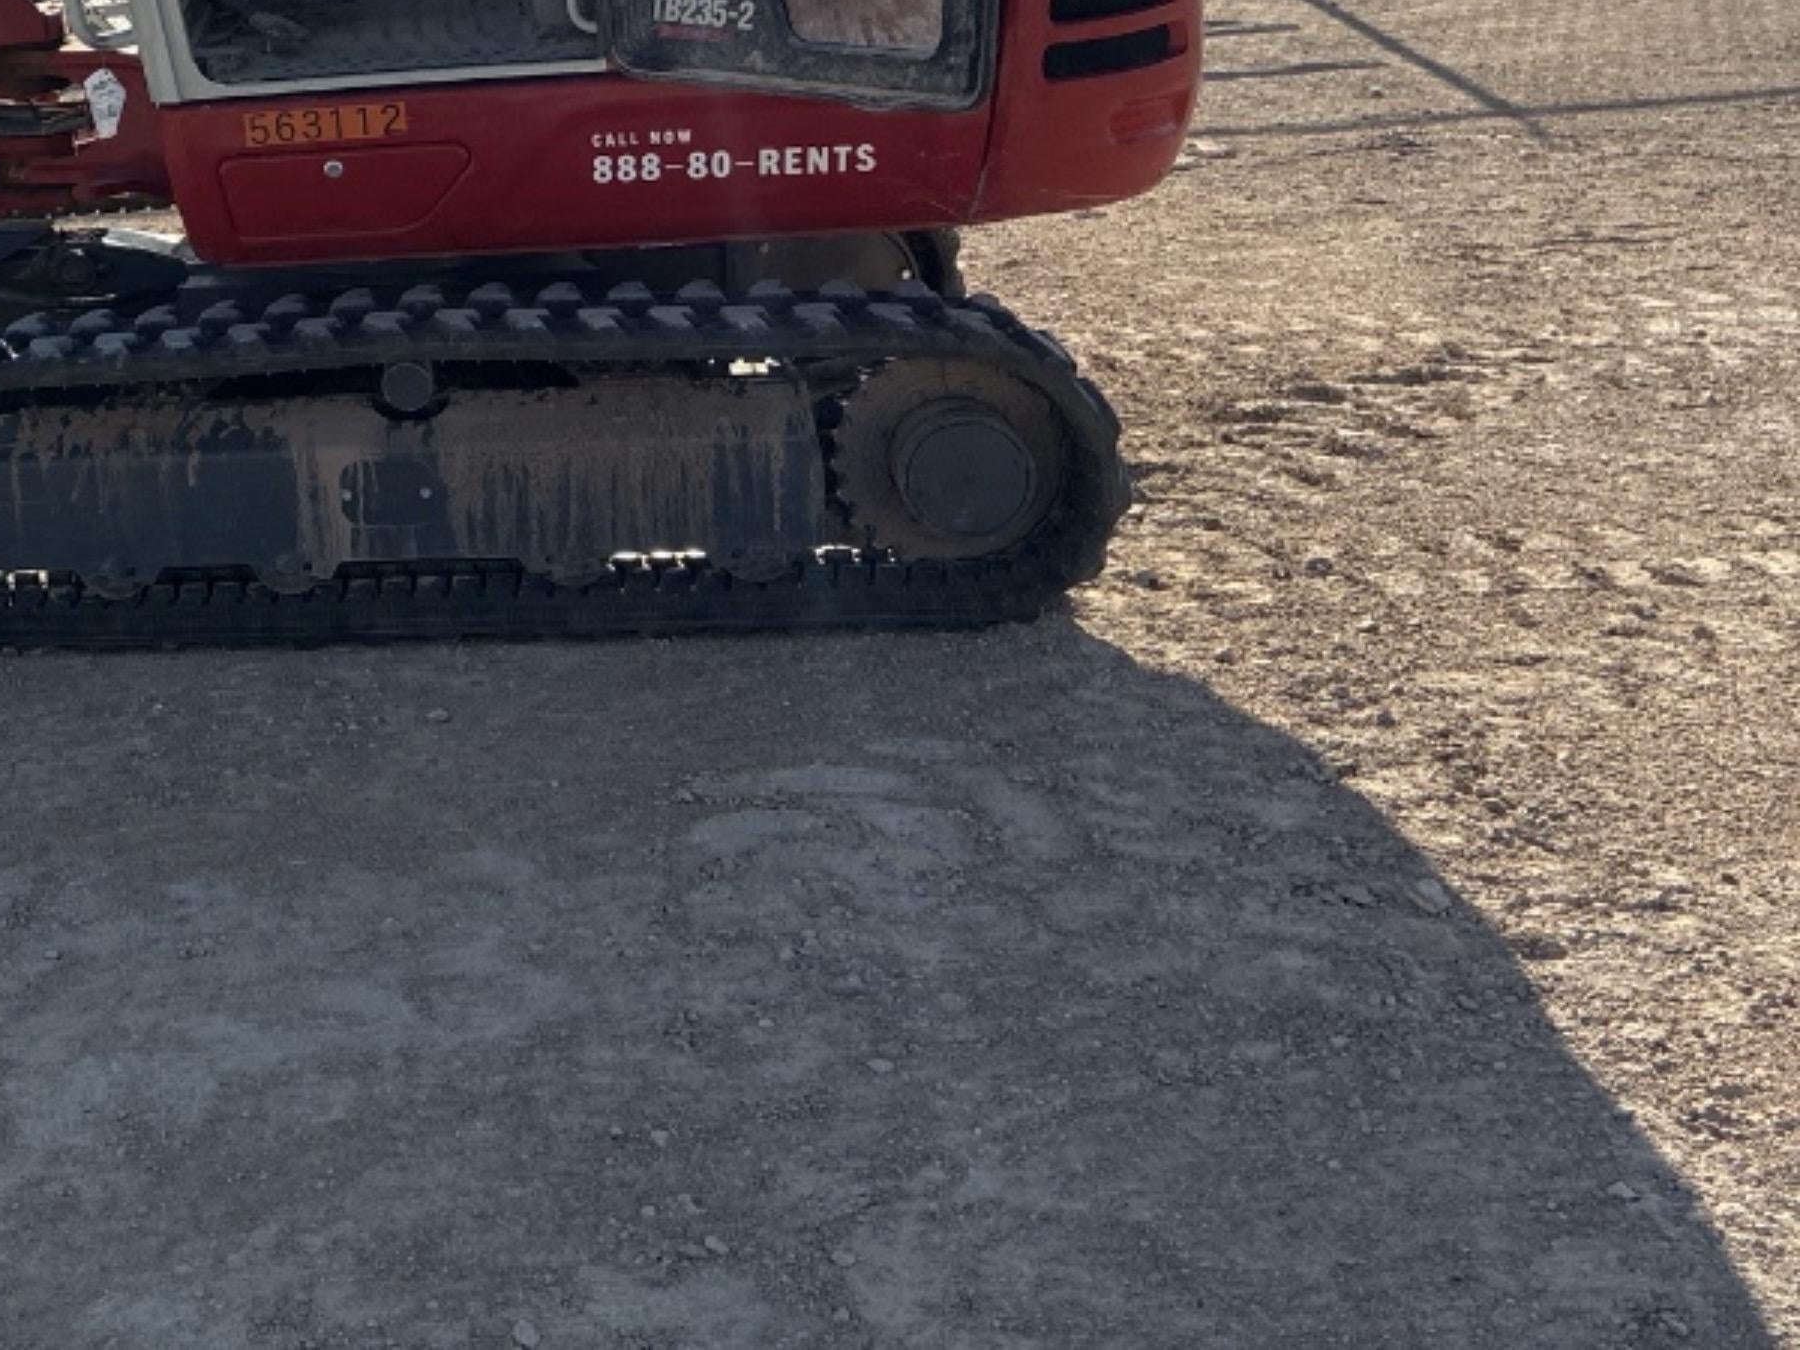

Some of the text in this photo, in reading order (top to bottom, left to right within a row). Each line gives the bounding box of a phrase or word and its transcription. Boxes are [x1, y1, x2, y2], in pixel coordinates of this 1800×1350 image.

[251, 103, 400, 145] 563112
[591, 128, 692, 148] CALL NOW
[592, 143, 877, 184] 888-80-RENTS
